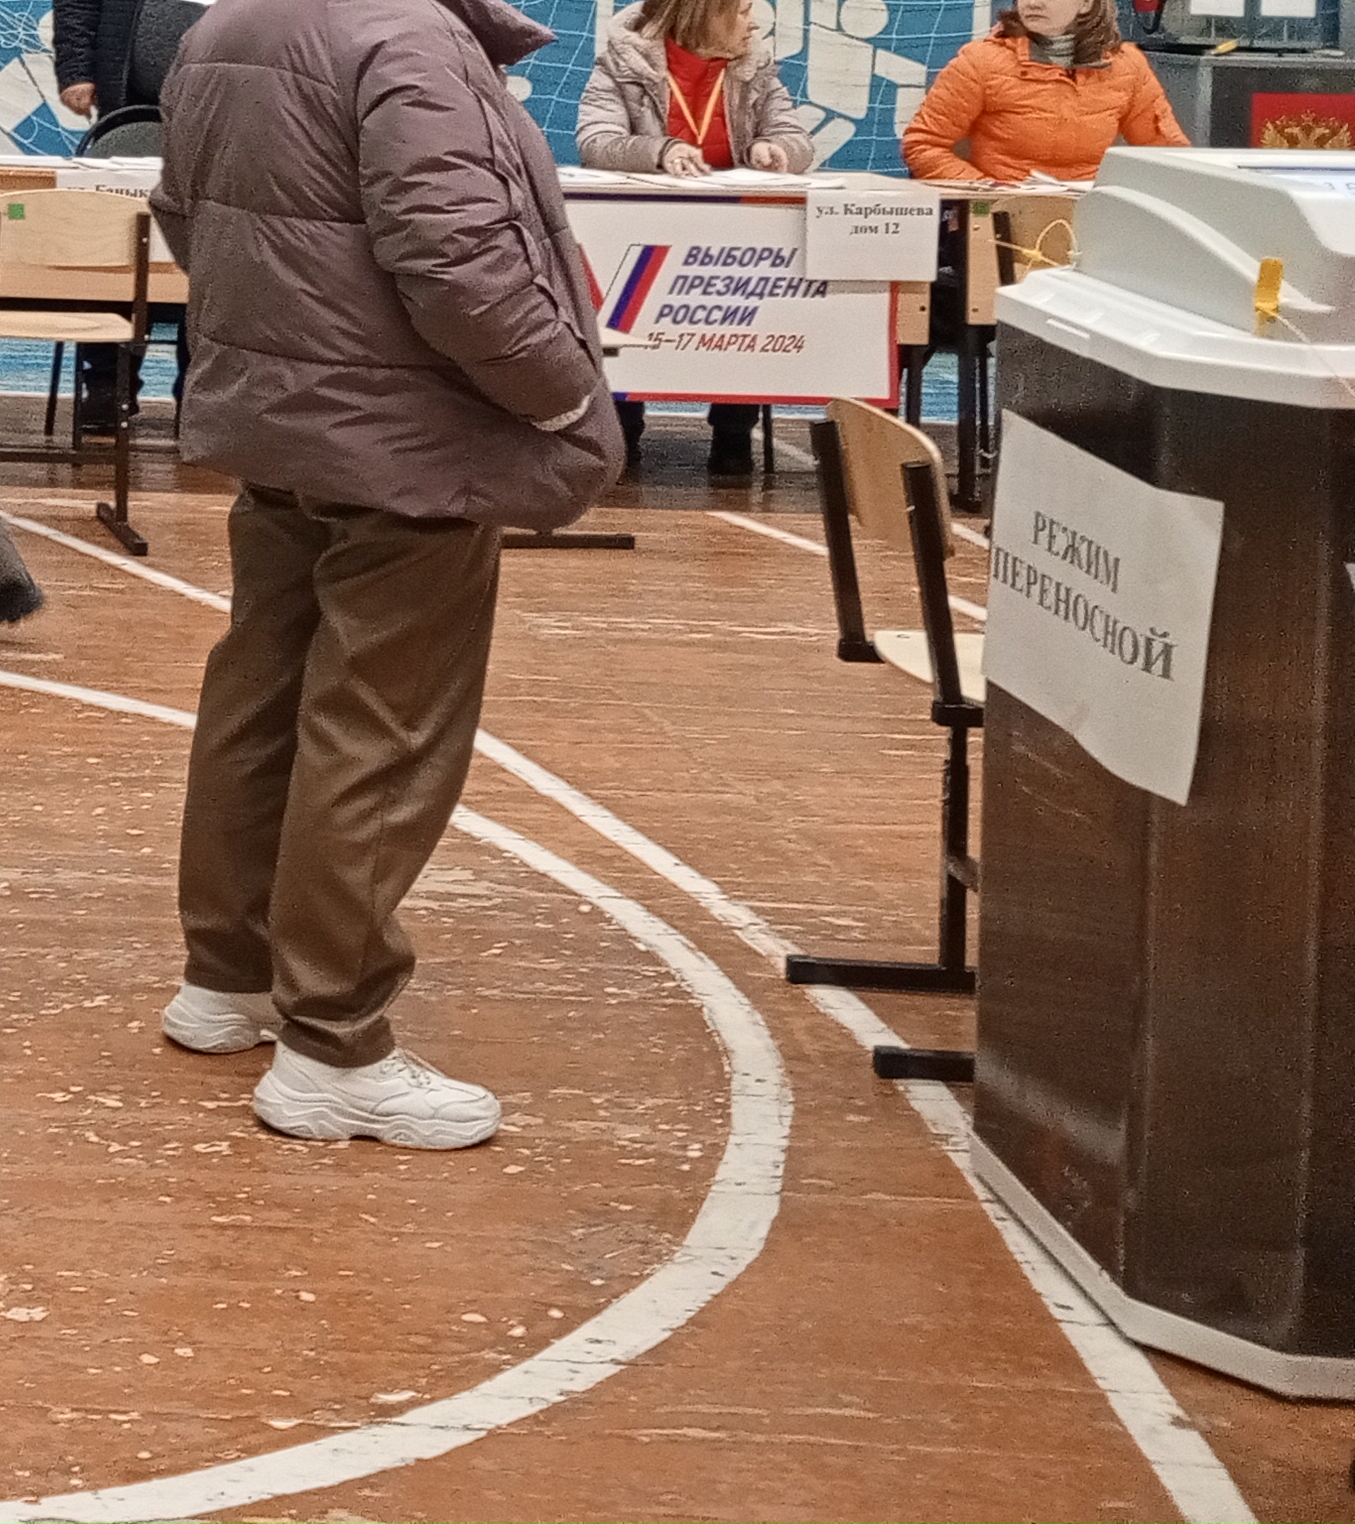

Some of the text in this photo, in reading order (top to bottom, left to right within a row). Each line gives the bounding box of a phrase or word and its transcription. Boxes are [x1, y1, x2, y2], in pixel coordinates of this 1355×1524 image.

[816, 203, 934, 219] ул. Карбышева
[850, 222, 901, 235] дом 12
[682, 245, 799, 269] ВЫБОРЫ
[666, 274, 829, 301] ПРЕЗИДЕНТА
[653, 304, 760, 327] РОССИИ
[695, 332, 759, 354] МАРТА
[759, 333, 807, 355] 2024
[1031, 509, 1121, 594] РЕЖИМ
[992, 546, 1179, 682] ПЕРЕНОСНОЙ
